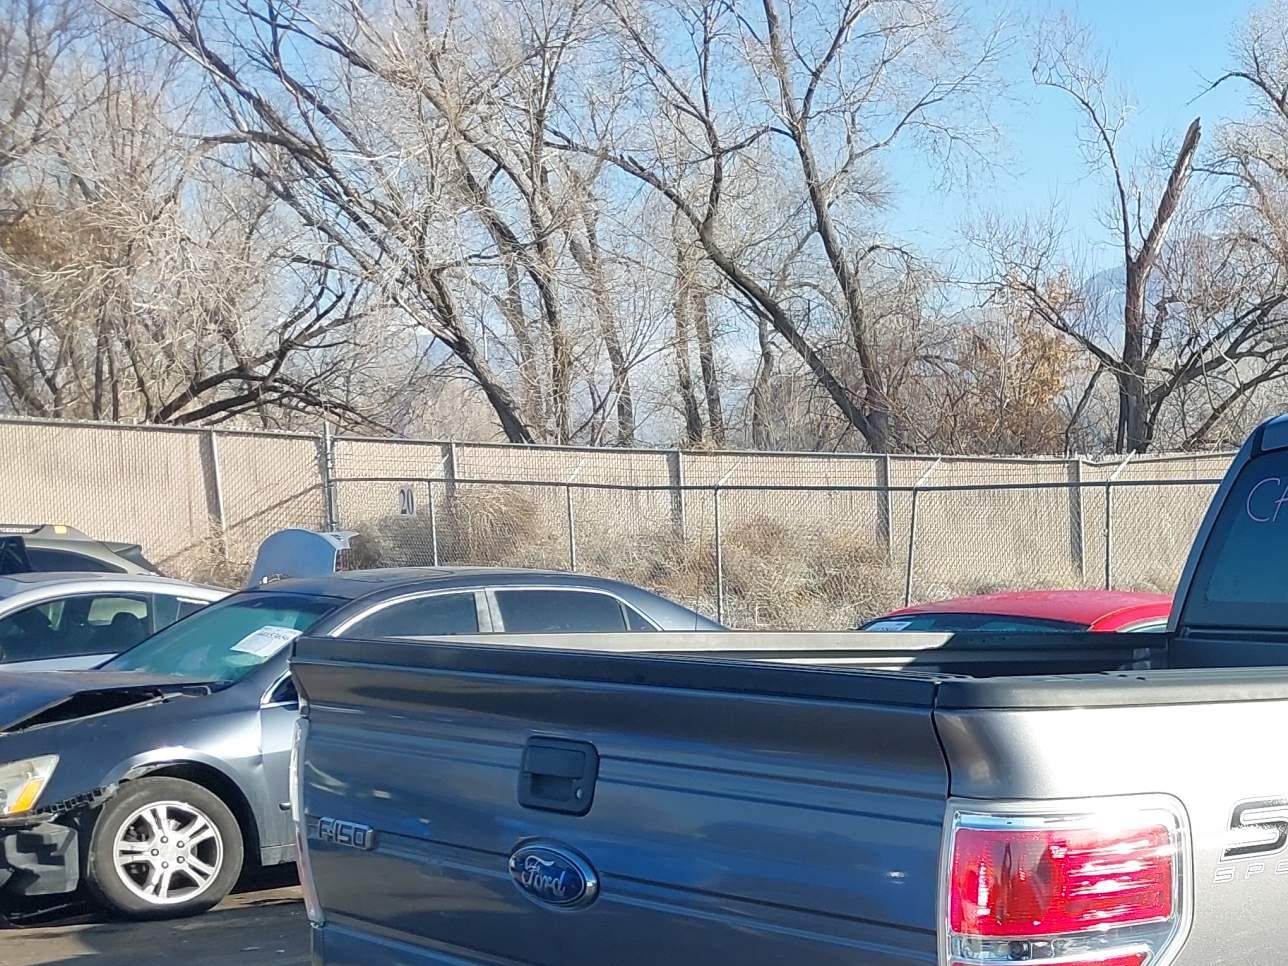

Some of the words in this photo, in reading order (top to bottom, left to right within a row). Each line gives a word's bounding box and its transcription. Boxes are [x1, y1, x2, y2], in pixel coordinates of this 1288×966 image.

[400, 488, 414, 515] 20
[318, 816, 371, 850] F-150
[521, 854, 567, 897] Ford
